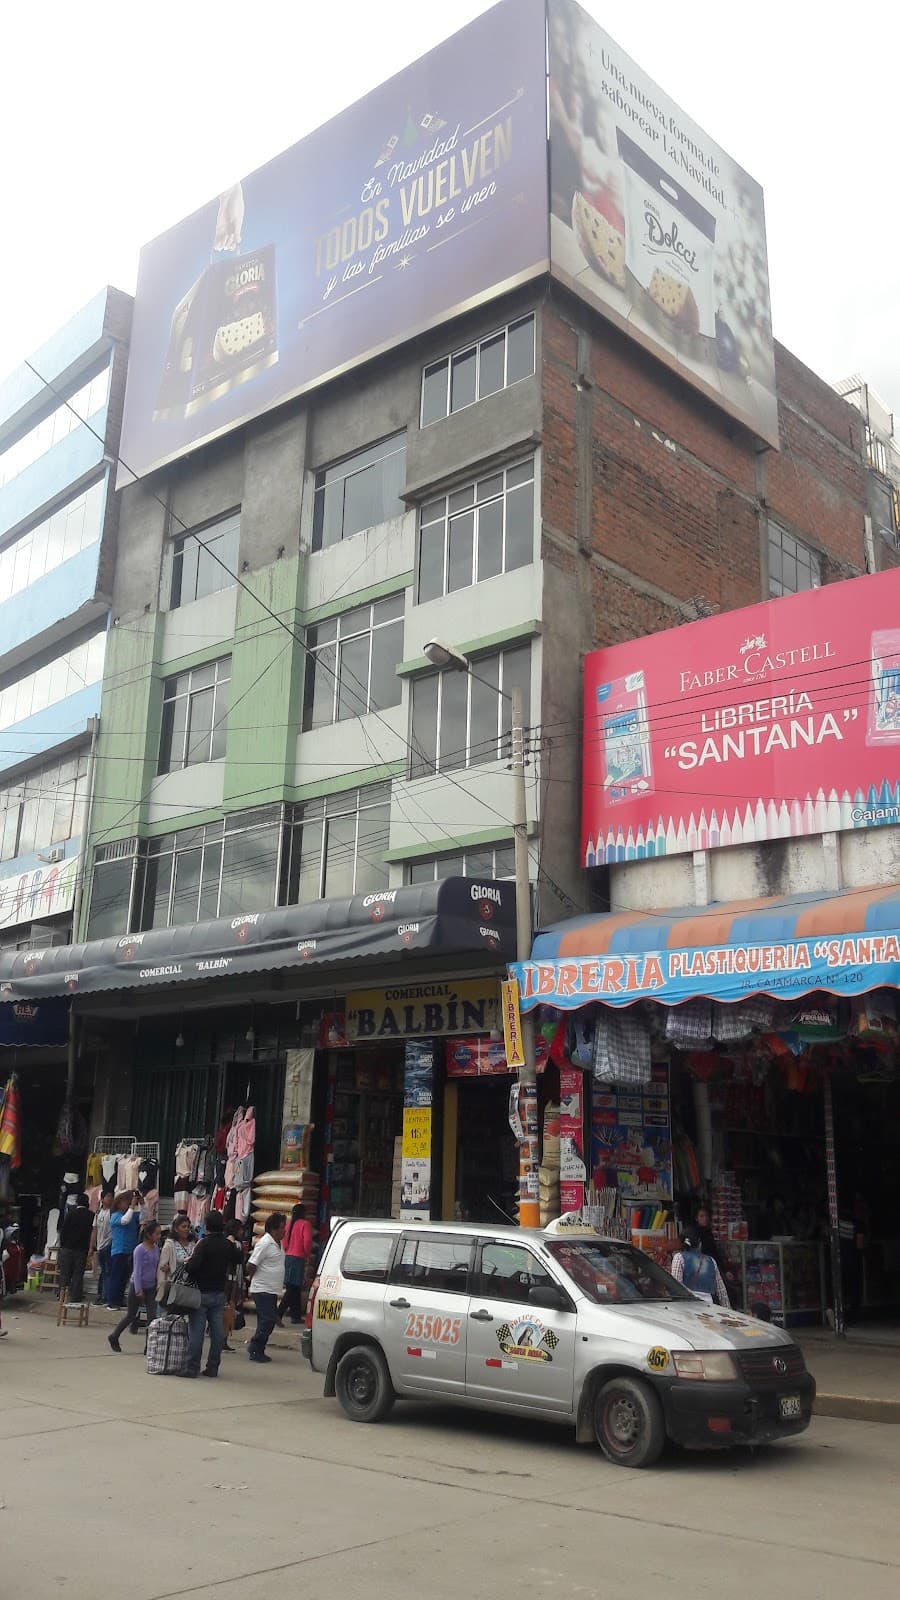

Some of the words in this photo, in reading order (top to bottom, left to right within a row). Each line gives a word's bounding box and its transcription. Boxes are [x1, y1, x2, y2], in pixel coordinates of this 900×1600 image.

[601, 48, 626, 88] Una
[629, 79, 666, 130] nueva
[668, 117, 706, 167] forma
[707, 155, 720, 177] de
[601, 79, 659, 142] saborear
[664, 135, 679, 164] La
[360, 177, 382, 202] En
[387, 123, 461, 187] Navidad
[314, 198, 390, 277] TODOS
[400, 116, 513, 227] VUELVEN
[322, 274, 337, 300] y
[342, 261, 366, 283] las
[369, 224, 430, 274] familias
[436, 207, 456, 228] se
[461, 181, 497, 214] unen
[644, 211, 699, 272] Dolcci
[224, 264, 265, 296] GLORIA
[680, 641, 836, 692] FABER-CASTELL
[701, 689, 813, 733] LIBRERÍA
[363, 890, 398, 907] GLORIA
[470, 884, 502, 906] GLORIA
[297, 940, 317, 952] GLORIA
[398, 923, 420, 936] GLORIA
[479, 926, 501, 941] GLORIA
[140, 964, 182, 978] COMERCIAL
[668, 943, 811, 978] PLASTIQUERIA
[385, 984, 451, 1001] COMERCIAL
[741, 979, 755, 990] JR.
[757, 976, 822, 988] CAJAMARCA
[845, 972, 864, 983] 120
[506, 984, 520, 1062] LIBRERIA
[404, 1311, 462, 1345] 255025
[509, 1314, 535, 1330] POLICE
[648, 1349, 666, 1367] 467
